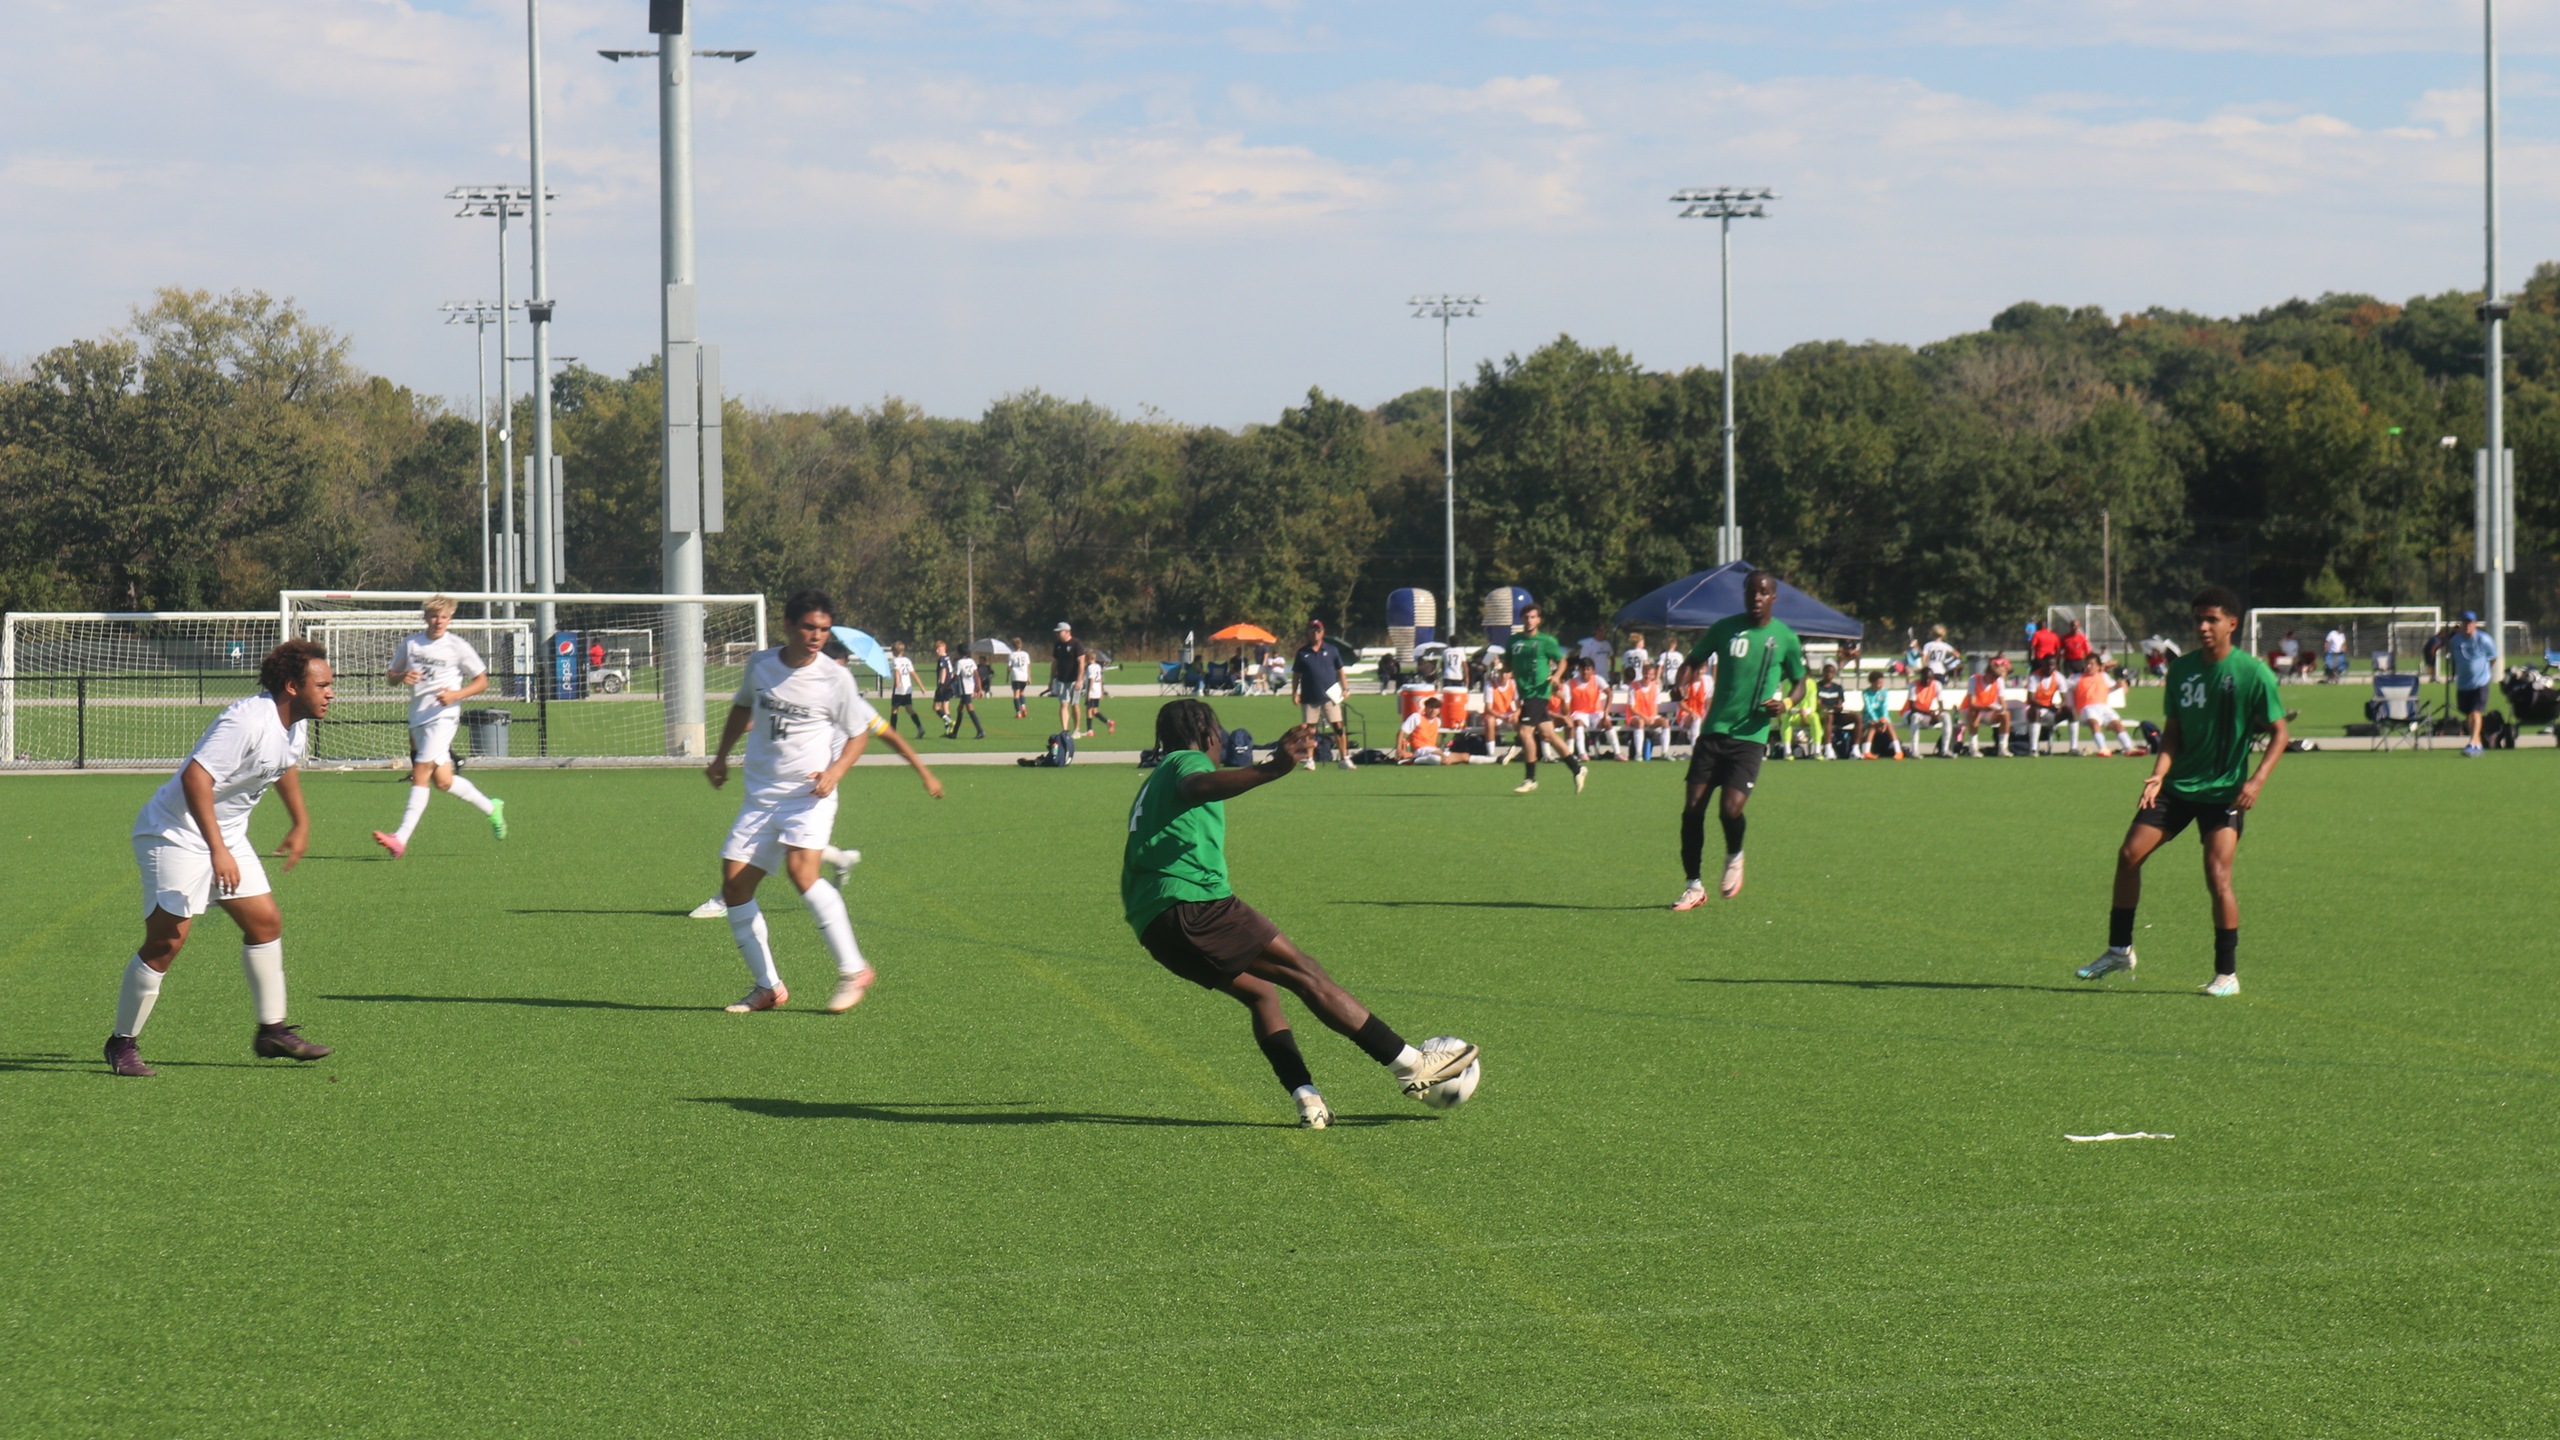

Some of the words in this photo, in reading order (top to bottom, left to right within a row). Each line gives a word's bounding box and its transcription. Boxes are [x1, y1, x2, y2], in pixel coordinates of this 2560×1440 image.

[231, 646, 241, 656] 4
[1729, 638, 1749, 658] 10
[1448, 654, 1458, 666] 17
[561, 659, 572, 690] pepsi
[2180, 682, 2206, 709] 34
